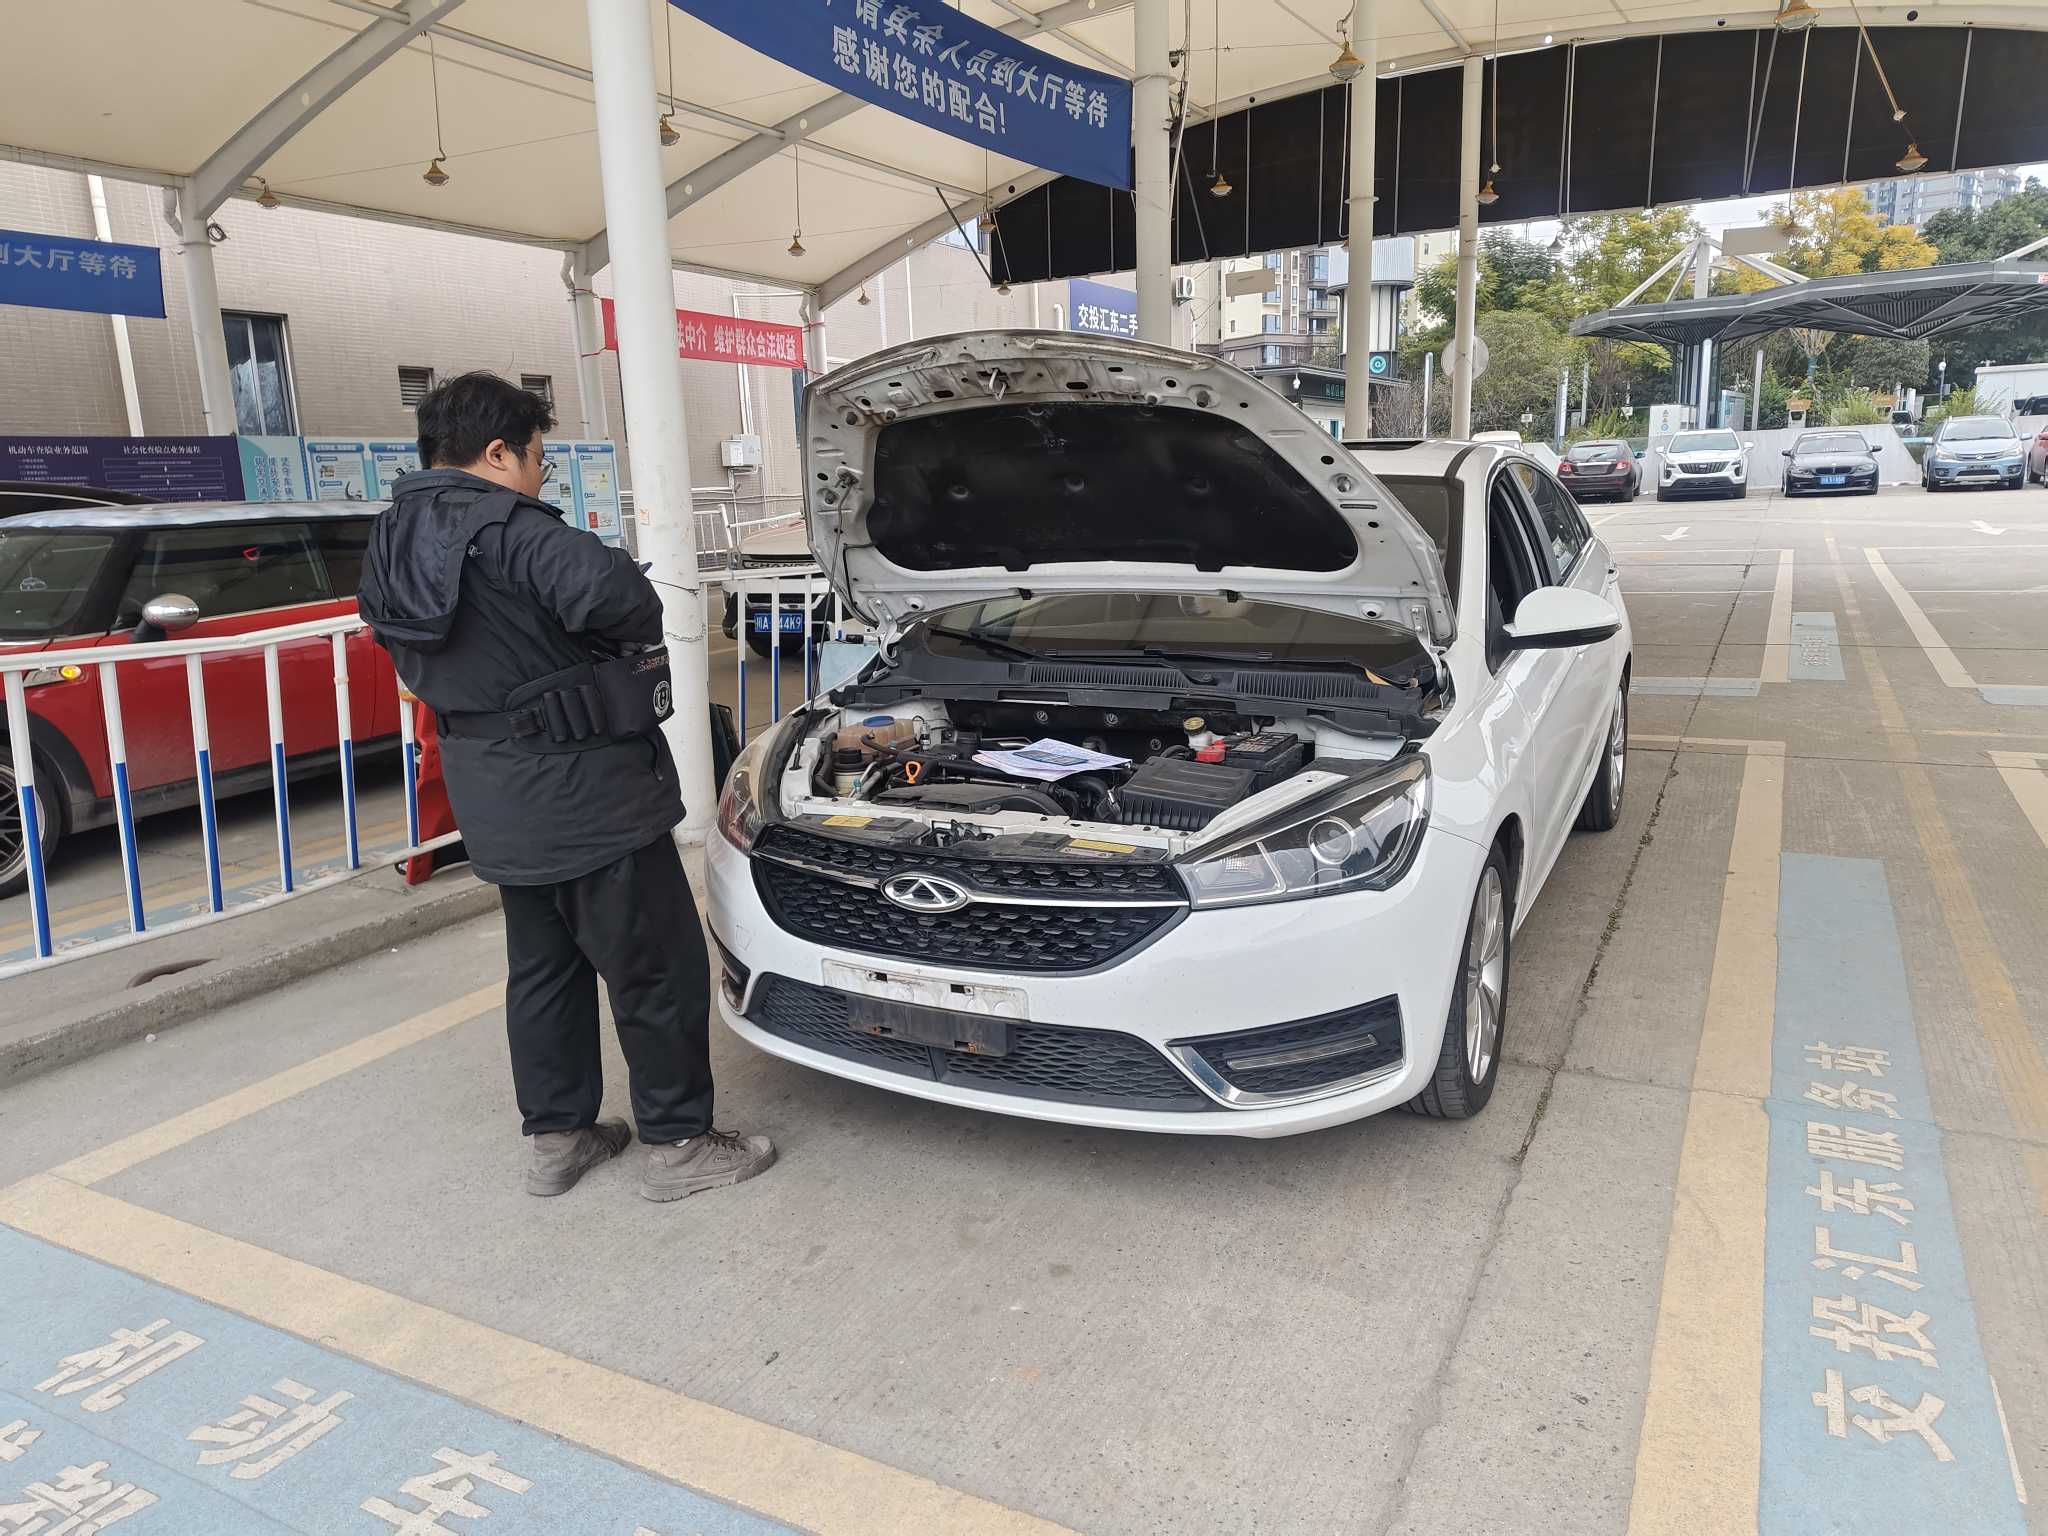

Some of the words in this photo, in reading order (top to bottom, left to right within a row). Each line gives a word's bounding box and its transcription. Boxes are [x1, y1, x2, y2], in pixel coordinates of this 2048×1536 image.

[855, 0, 1108, 128] 请其余人员到大厅等待
[713, 324, 797, 360] 维护群众合法权益
[1078, 303, 1138, 336] 交投汇东二手
[1804, 1040, 1957, 1463] 交投汇东服务站
